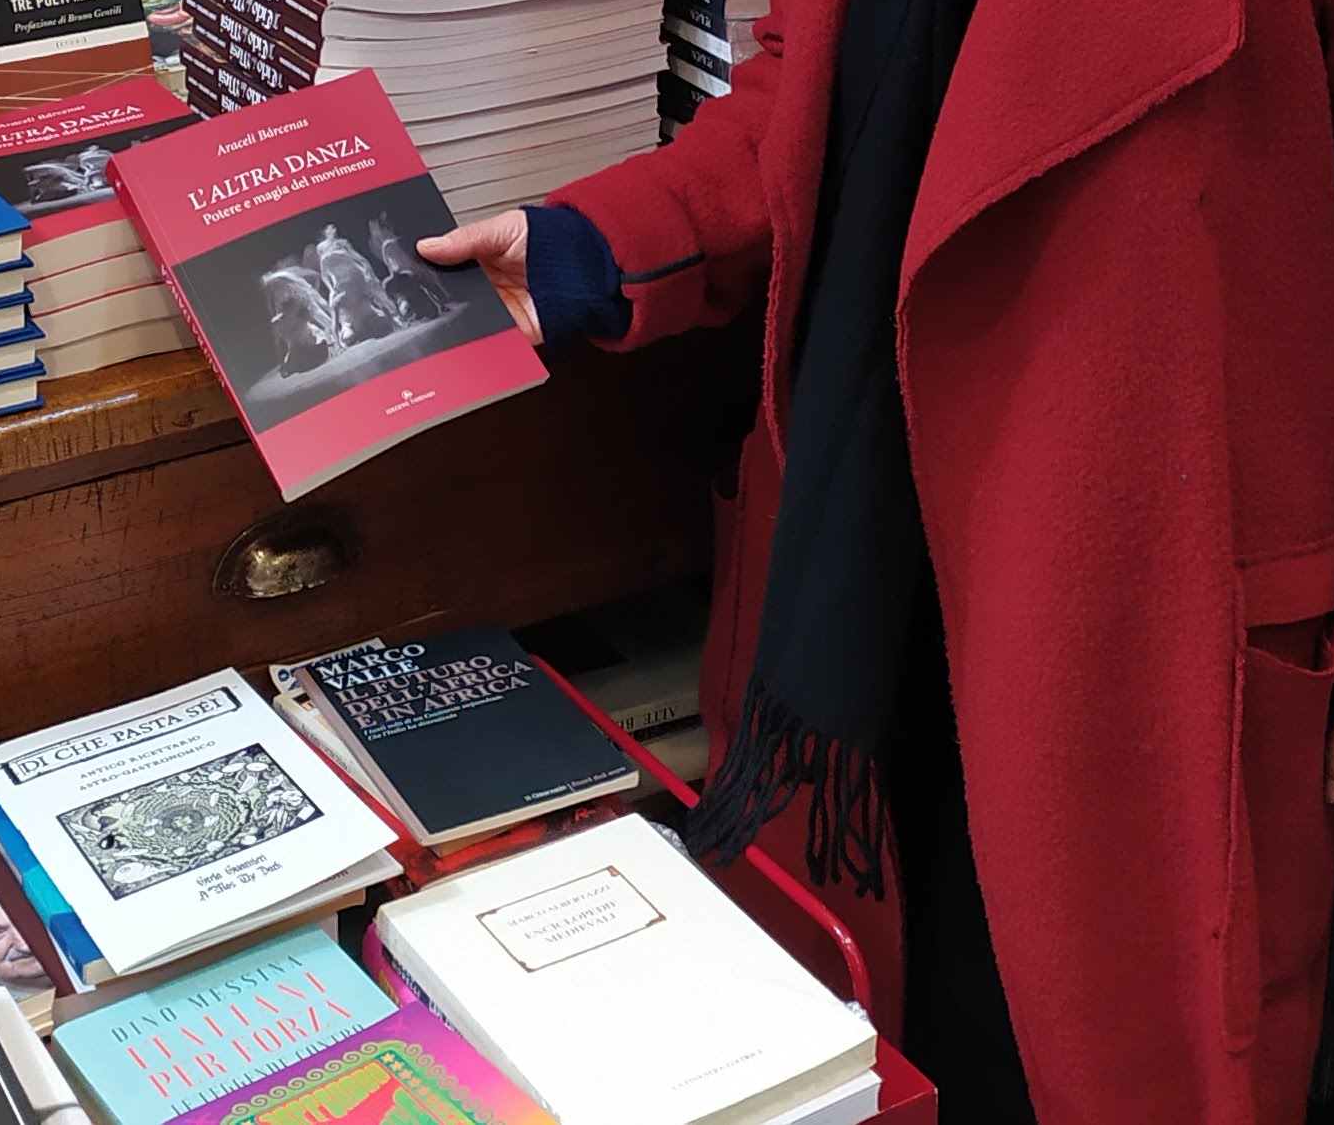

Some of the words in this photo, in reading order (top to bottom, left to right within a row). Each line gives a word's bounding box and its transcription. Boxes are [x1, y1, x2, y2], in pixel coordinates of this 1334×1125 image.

[13, 15, 57, 34] Prefazione
[57, 12, 68, 25] di
[68, 10, 92, 24] Bruno
[93, 4, 122, 21] Gentili
[58, 104, 142, 127] DANZA
[215, 131, 264, 157] Araceli
[264, 117, 310, 142] Bárcenas
[187, 165, 285, 212] L'ALTRA
[284, 133, 372, 175] DANZA
[202, 202, 242, 226] Potere
[243, 198, 253, 209] e
[253, 184, 290, 207] magia
[290, 174, 312, 192] del
[310, 154, 377, 184] movimento
[316, 642, 427, 680] MARCO
[324, 659, 421, 692] VALLE
[335, 686, 369, 704] IL
[373, 654, 494, 695] FUTURO
[343, 660, 534, 717] DELL'AFRICA
[352, 712, 378, 730] E
[382, 703, 416, 722] IN
[423, 676, 532, 712] AFRICA
[20, 754, 51, 774] DI
[53, 736, 111, 764] CHE
[112, 711, 182, 745] PASTA
[184, 696, 225, 718] SEI
[78, 759, 127, 781] ANTICO
[128, 733, 203, 763] RICETTARIO
[78, 739, 218, 793] ASTRO-GASTRONOMICO
[523, 899, 619, 942] ENCICLOPEDIE
[545, 883, 612, 915] ALBERTAZZI
[544, 912, 618, 945] MEDIEVALI
[110, 1006, 181, 1043] DINO
[187, 954, 305, 1012] MESSINA
[125, 971, 327, 1071] ITALIANI
[147, 1051, 228, 1099] PER
[231, 999, 353, 1064] FORZA
